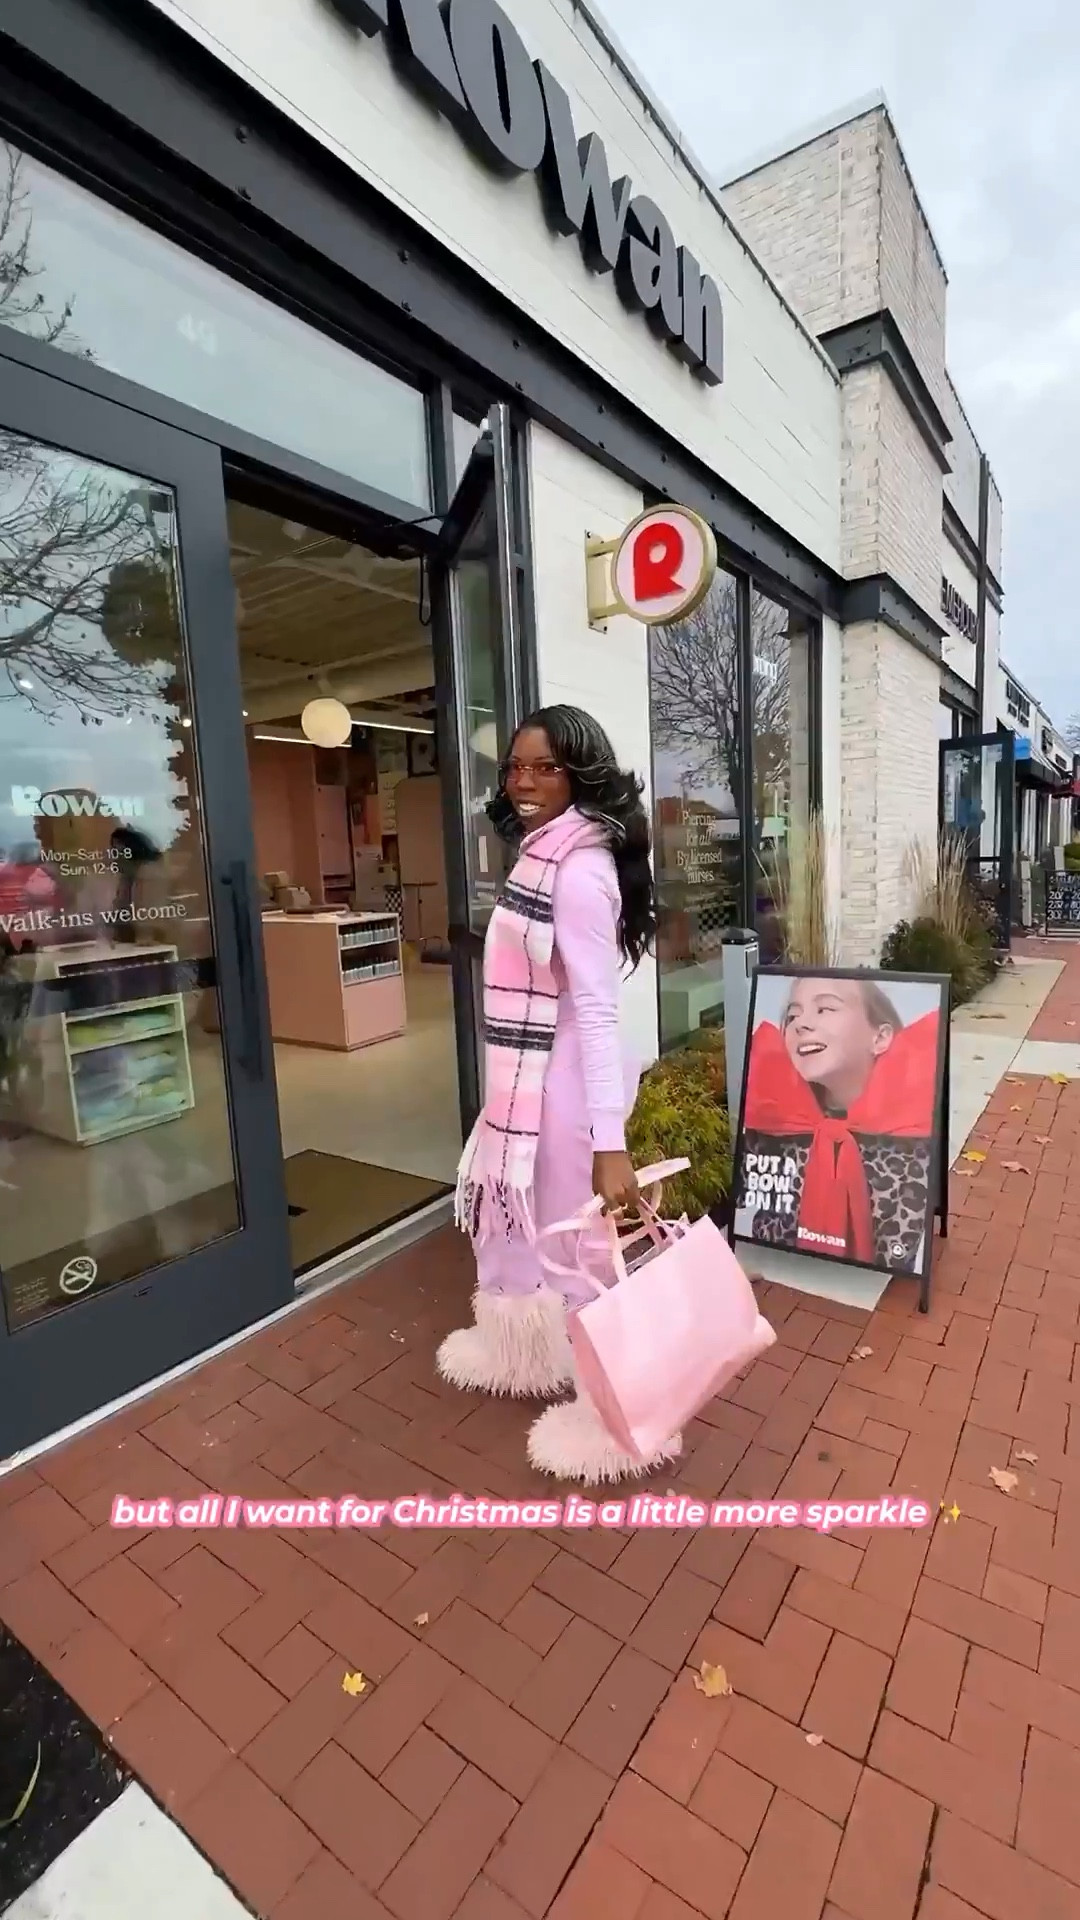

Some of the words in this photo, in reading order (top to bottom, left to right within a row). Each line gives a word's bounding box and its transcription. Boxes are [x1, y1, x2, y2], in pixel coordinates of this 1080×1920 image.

[632, 522, 687, 602] R
[10, 784, 145, 818] Rowan
[682, 810, 717, 830] Piercing
[699, 828, 713, 846] all
[106, 847, 133, 860] 10-8
[676, 849, 690, 871] By
[690, 847, 723, 865] licensed
[59, 864, 90, 877] Sun:
[93, 861, 120, 874] 12-6
[687, 870, 715, 885] nurses
[100, 901, 188, 925] welcome
[745, 1153, 781, 1175] PUT
[783, 1156, 797, 1176] A
[747, 1171, 791, 1193] BOW
[744, 1190, 771, 1211] ON
[775, 1193, 795, 1215] IT
[796, 1226, 847, 1248] Rowan
